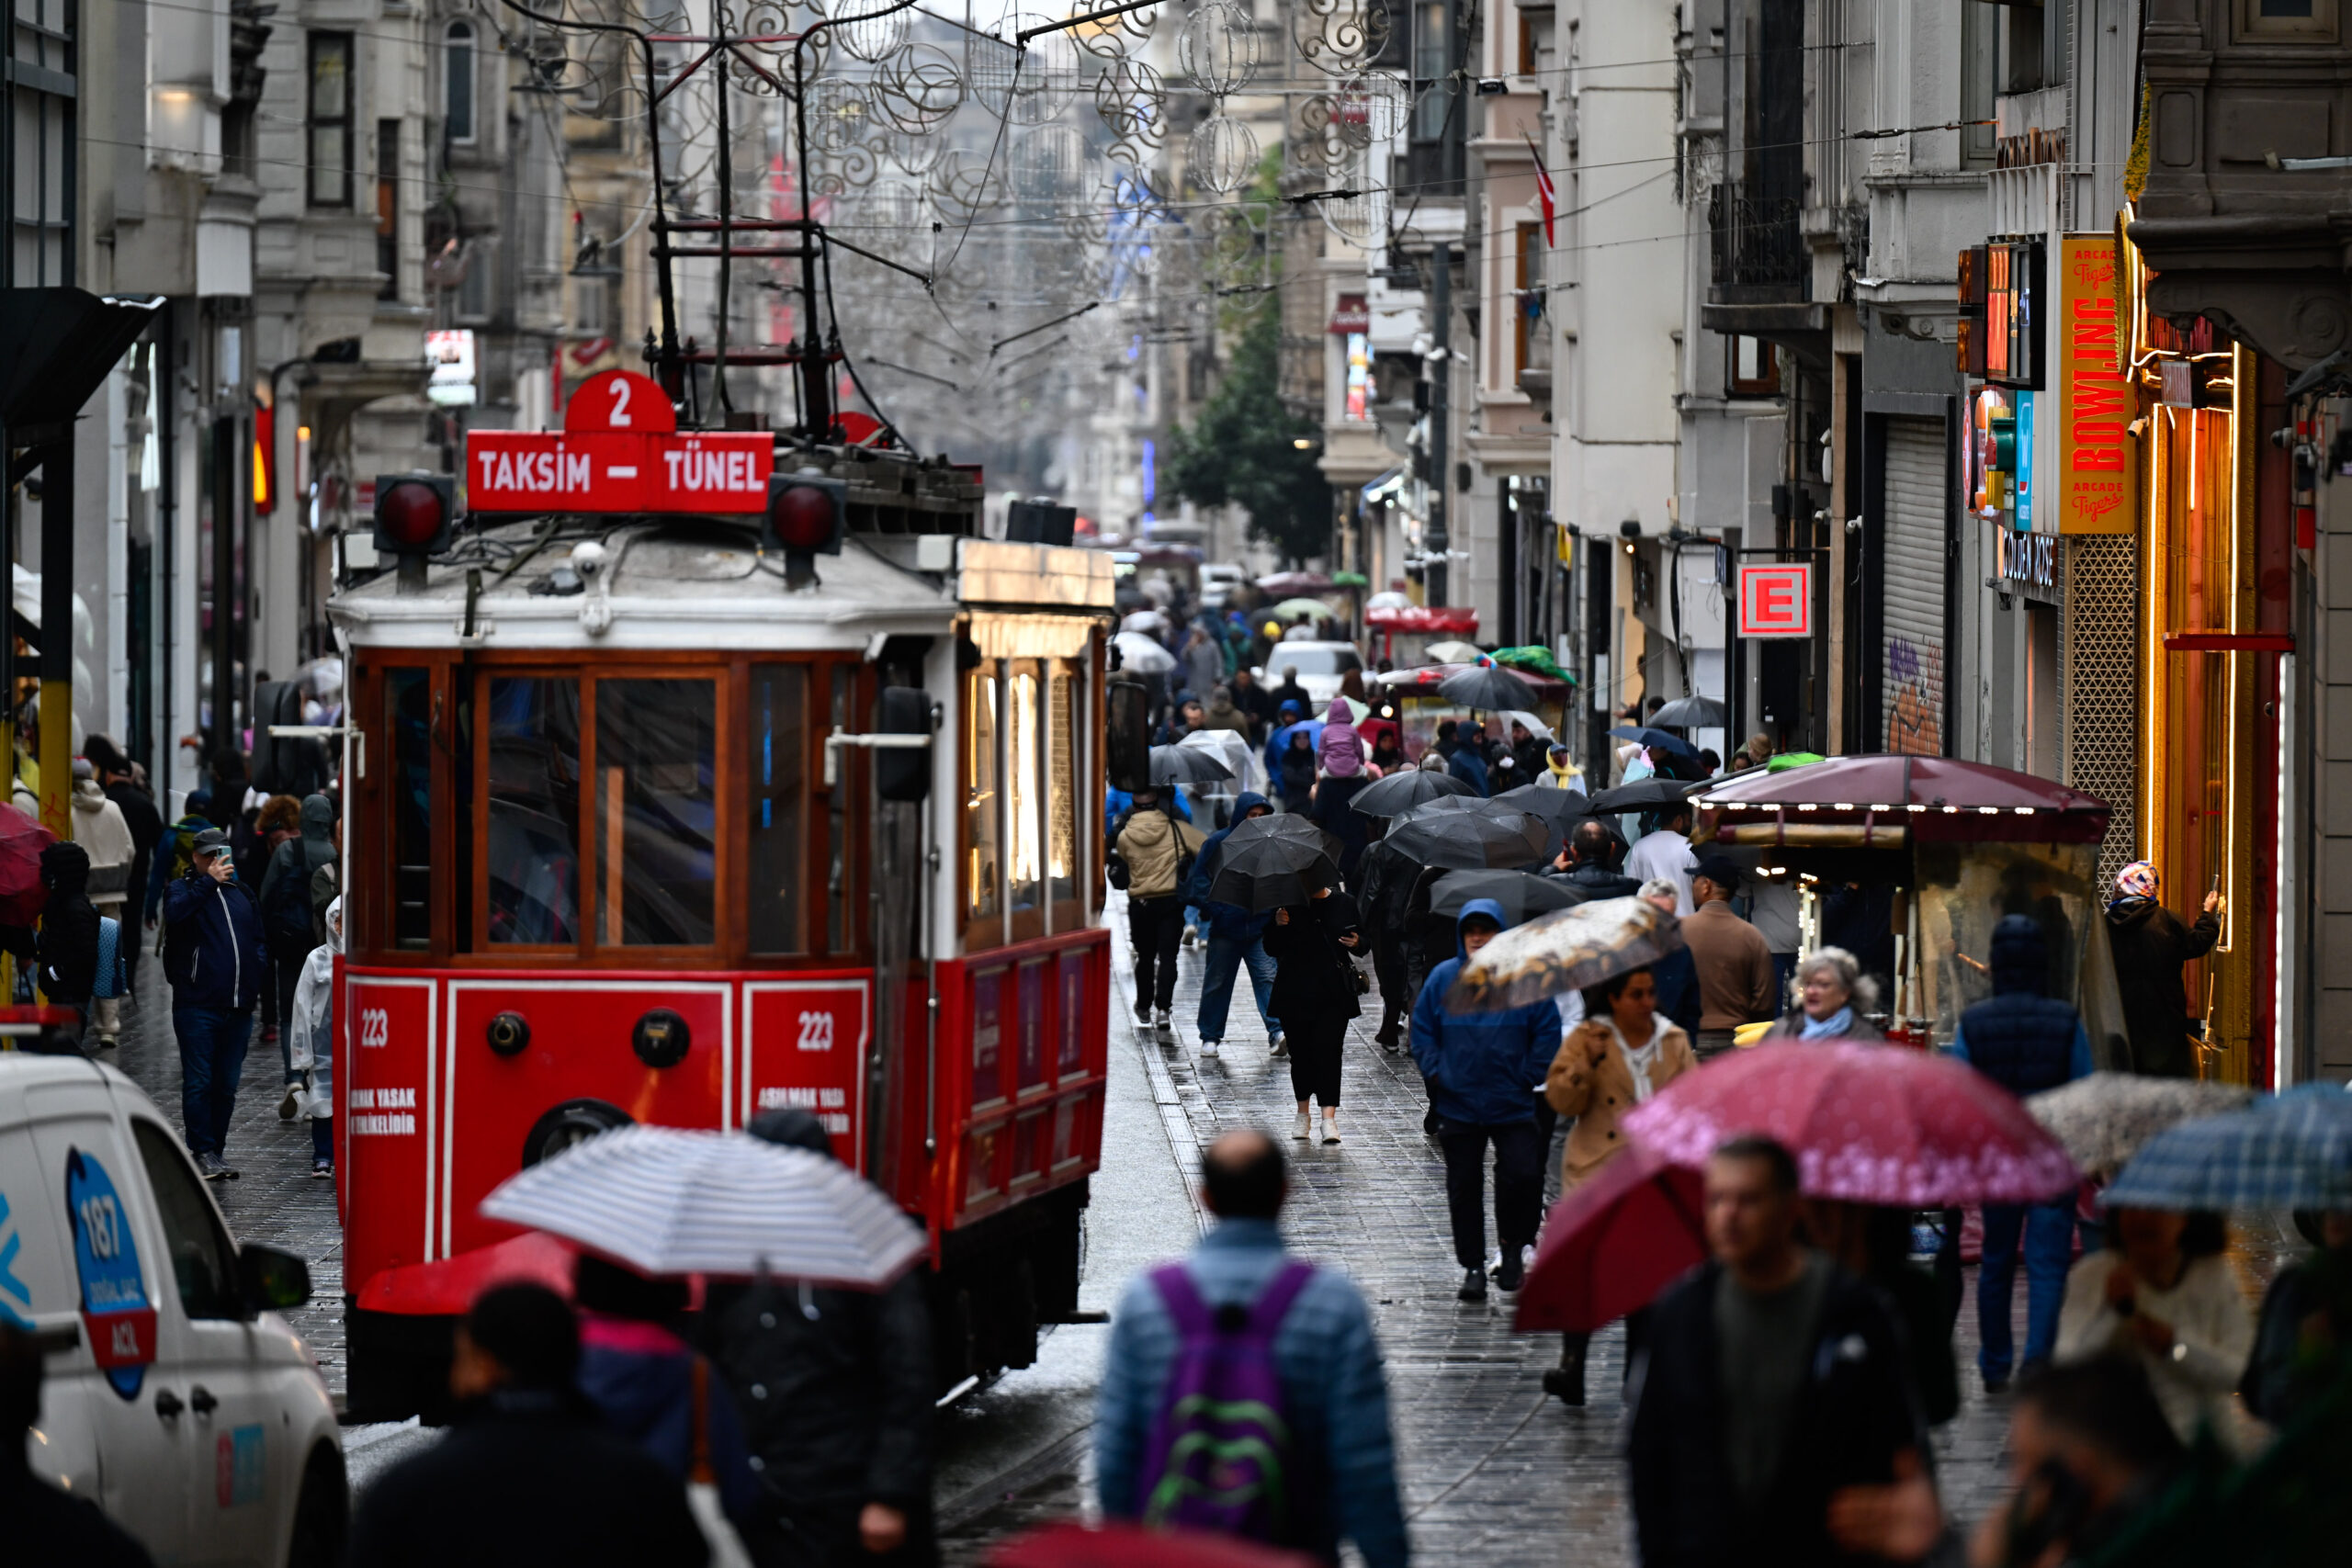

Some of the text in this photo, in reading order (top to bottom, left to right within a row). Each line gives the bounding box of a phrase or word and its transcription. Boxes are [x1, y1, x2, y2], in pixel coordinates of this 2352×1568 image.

[2074, 250, 2115, 260] ARCAD
[2073, 263, 2115, 291] Tiger
[609, 378, 632, 427] 2
[2072, 298, 2125, 473] BOWLING
[478, 441, 592, 493] TAKSİM
[663, 439, 765, 492] TÜNEL
[2073, 482, 2124, 492] ARCADE
[2072, 493, 2124, 523] Tigers
[2034, 536, 2054, 587] ROSE
[1756, 578, 1793, 623] E
[361, 1007, 389, 1049] 223
[797, 1010, 834, 1053] 223
[376, 1087, 416, 1110] YASAK
[80, 1194, 120, 1259] 187
